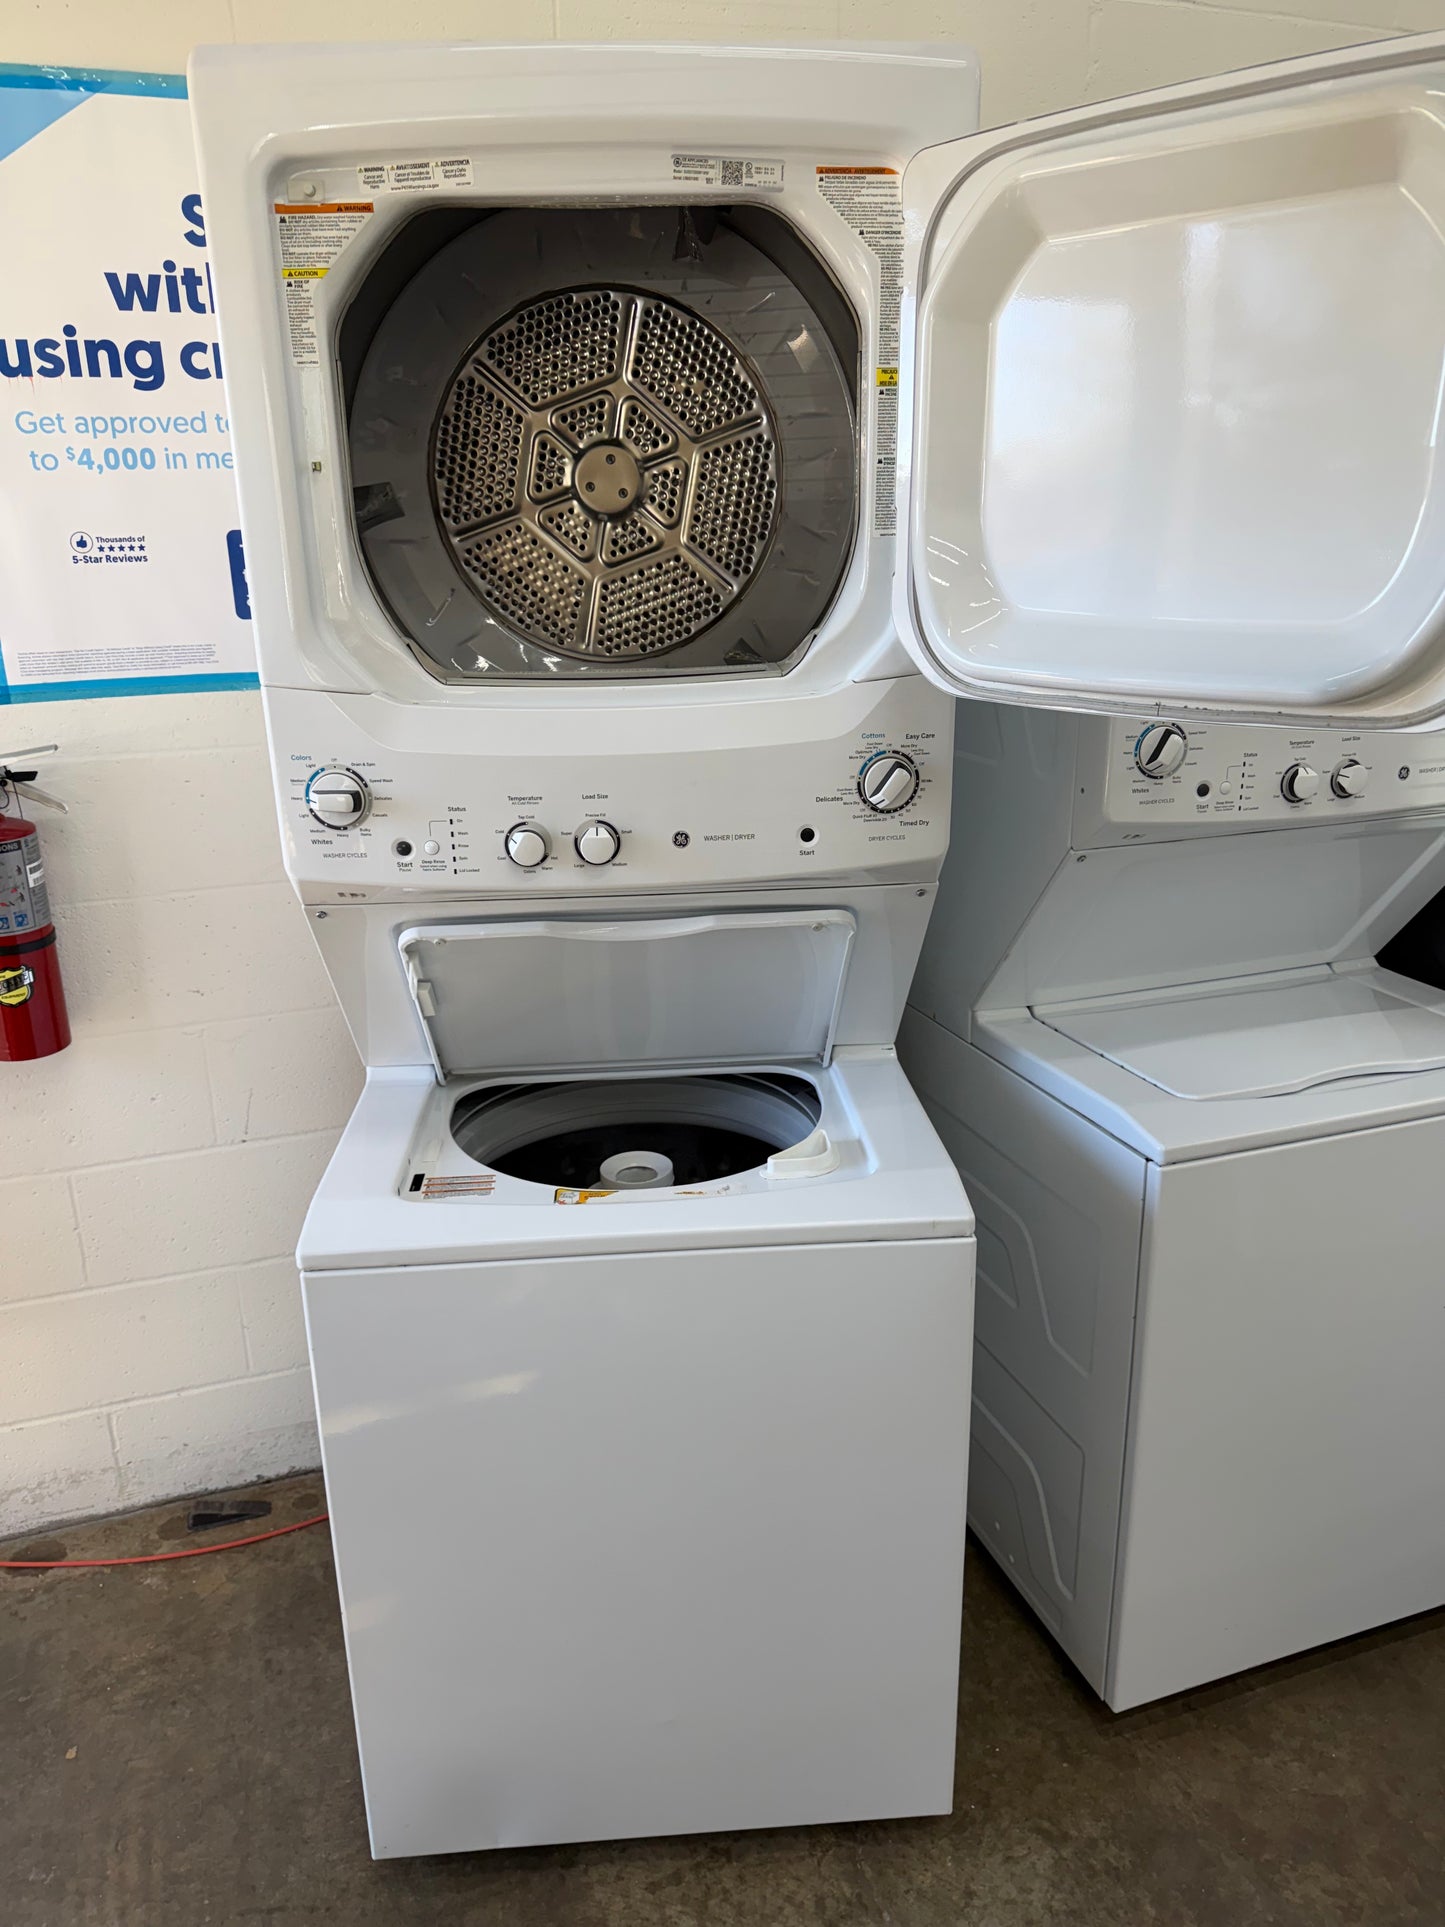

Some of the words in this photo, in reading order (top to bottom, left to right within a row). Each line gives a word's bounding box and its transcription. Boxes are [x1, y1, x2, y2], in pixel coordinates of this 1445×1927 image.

[104, 259, 215, 314] wit
[0, 324, 166, 391] using
[15, 411, 67, 434] Get
[74, 411, 207, 439] approved
[29, 450, 59, 472] to
[66, 446, 156, 475] $4,000
[164, 447, 188, 470] in
[95, 536, 134, 544] Thousands
[135, 535, 145, 543] of
[72, 555, 103, 564] 5-Star
[105, 554, 148, 563] Reviews
[703, 834, 731, 842] WASHER
[734, 833, 755, 841] DRYER
